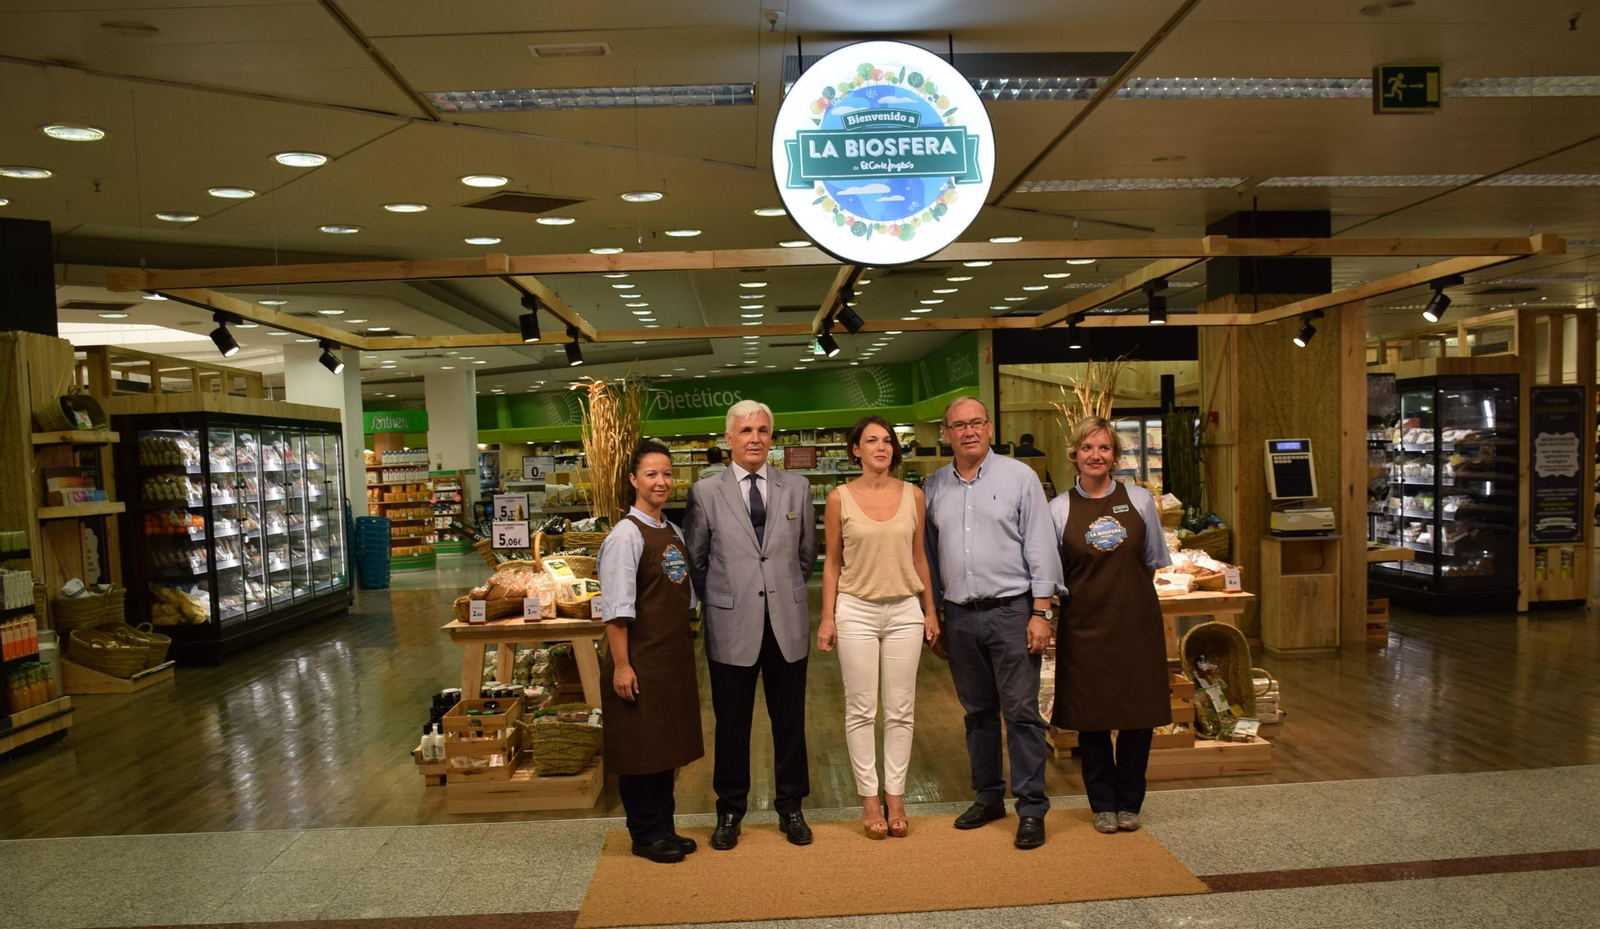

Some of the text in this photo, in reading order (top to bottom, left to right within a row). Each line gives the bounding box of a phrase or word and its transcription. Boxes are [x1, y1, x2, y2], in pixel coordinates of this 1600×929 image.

[847, 112, 915, 125] Bienvenido a
[808, 136, 958, 158] LA BIOSFERA
[656, 388, 743, 411] Dietéticos
[499, 533, 522, 547] 5,06€
